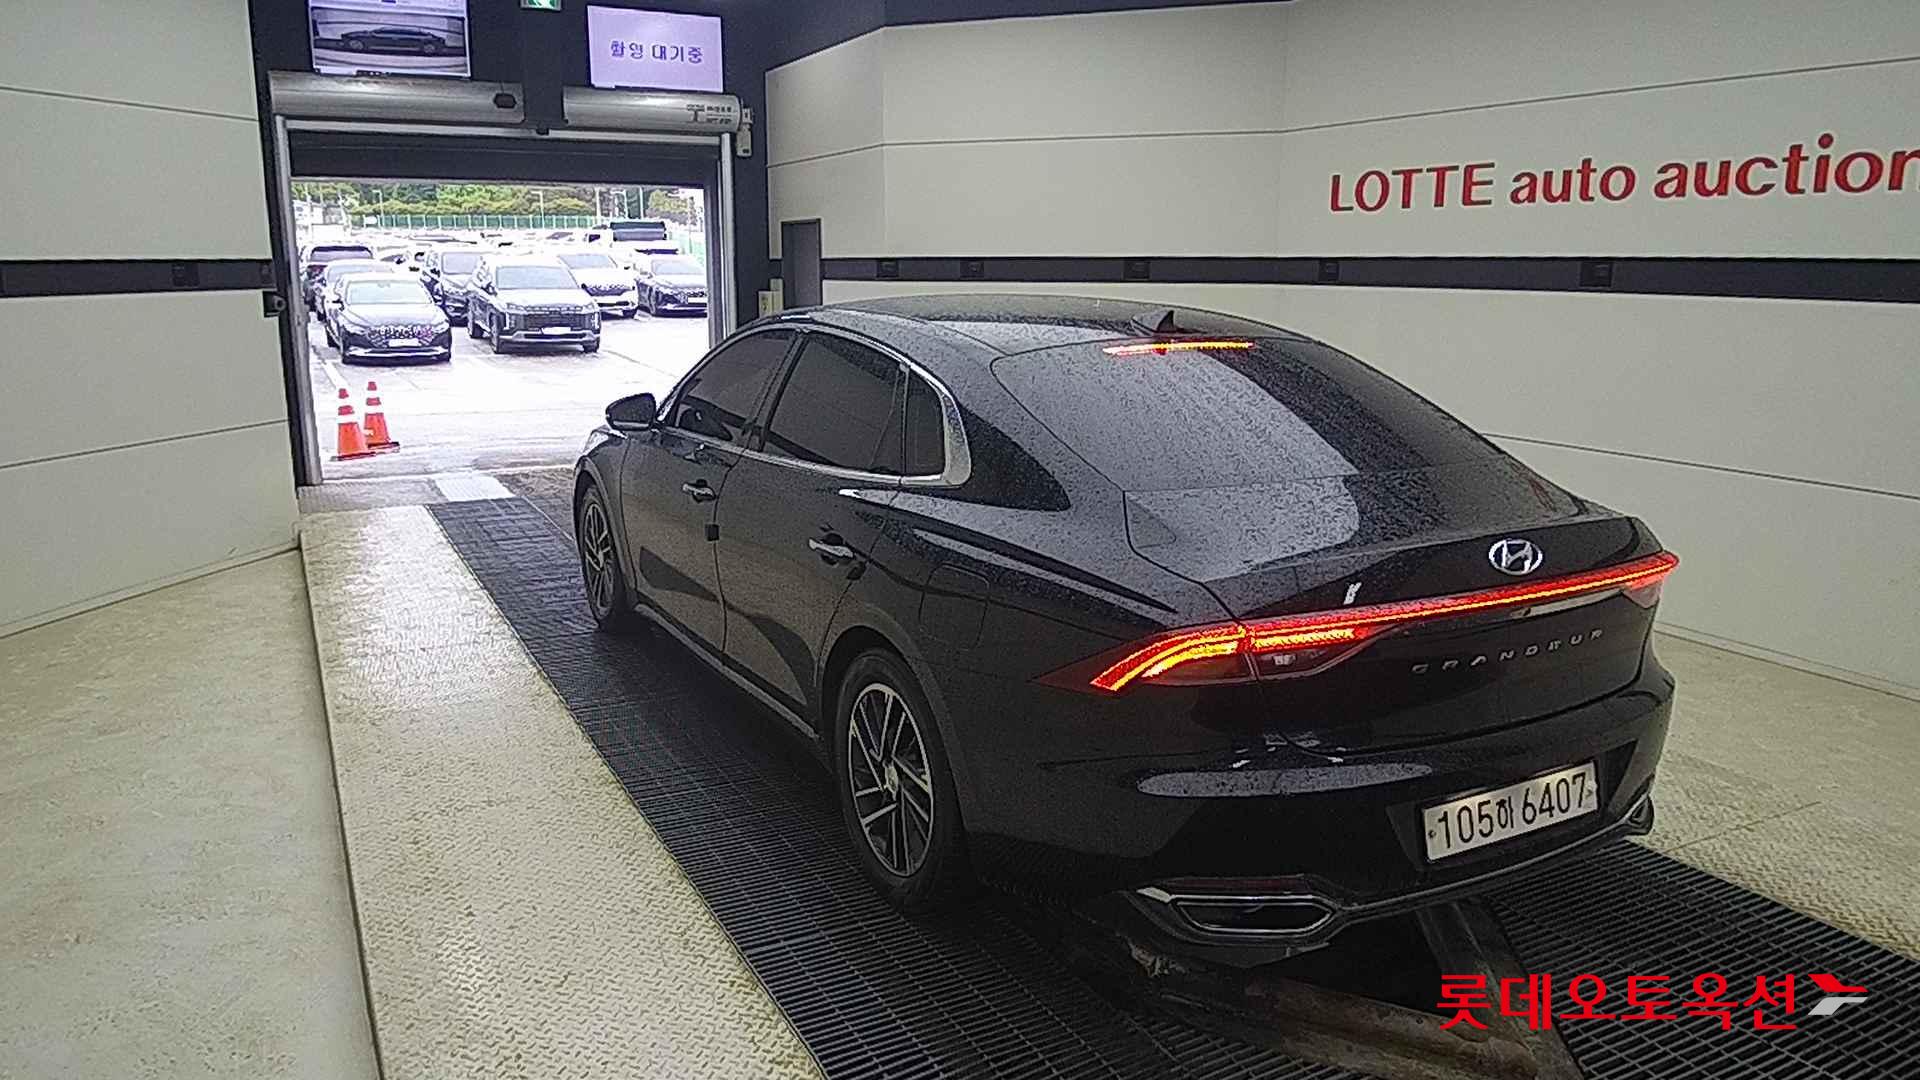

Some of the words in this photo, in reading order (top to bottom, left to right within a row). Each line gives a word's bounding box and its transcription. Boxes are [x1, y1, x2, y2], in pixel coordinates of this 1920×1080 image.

[651, 43, 703, 64] 대기중
[1329, 161, 1496, 212] LOTTE
[1509, 157, 1637, 205] auto
[1411, 628, 1604, 674] GRANDEUR
[1437, 796, 1514, 849] 105하
[1521, 772, 1587, 825] 6407
